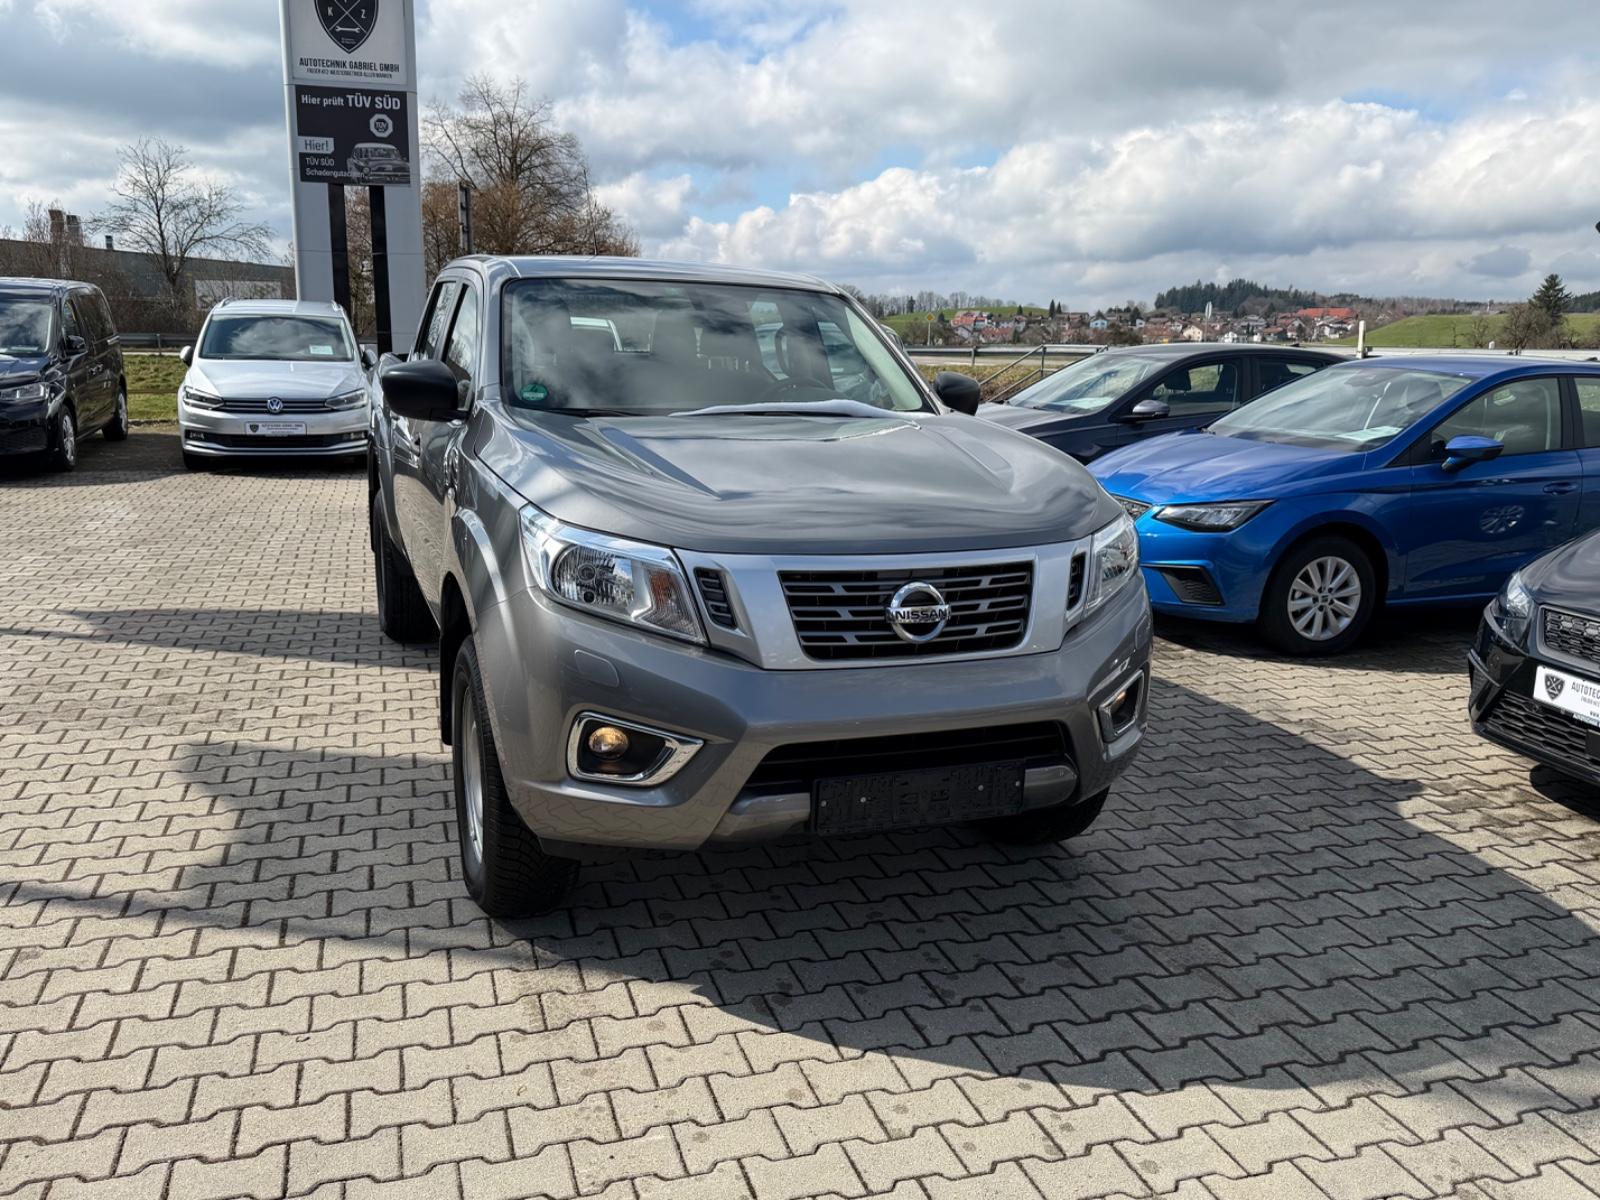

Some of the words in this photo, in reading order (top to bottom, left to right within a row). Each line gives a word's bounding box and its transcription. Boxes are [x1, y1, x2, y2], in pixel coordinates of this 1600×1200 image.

[327, 6, 333, 17] K
[299, 57, 347, 70] AUTOTECHNIK
[349, 60, 378, 71] GABRIEL
[379, 63, 400, 73] GMBH
[301, 94, 321, 105] Hier
[323, 95, 345, 107] prüft
[346, 92, 371, 108] TÜV
[374, 94, 401, 110] SÜD
[304, 139, 328, 151] Hier!
[305, 156, 319, 166] TÜV
[320, 157, 335, 167] SÜD
[895, 609, 948, 621] NISSAN
